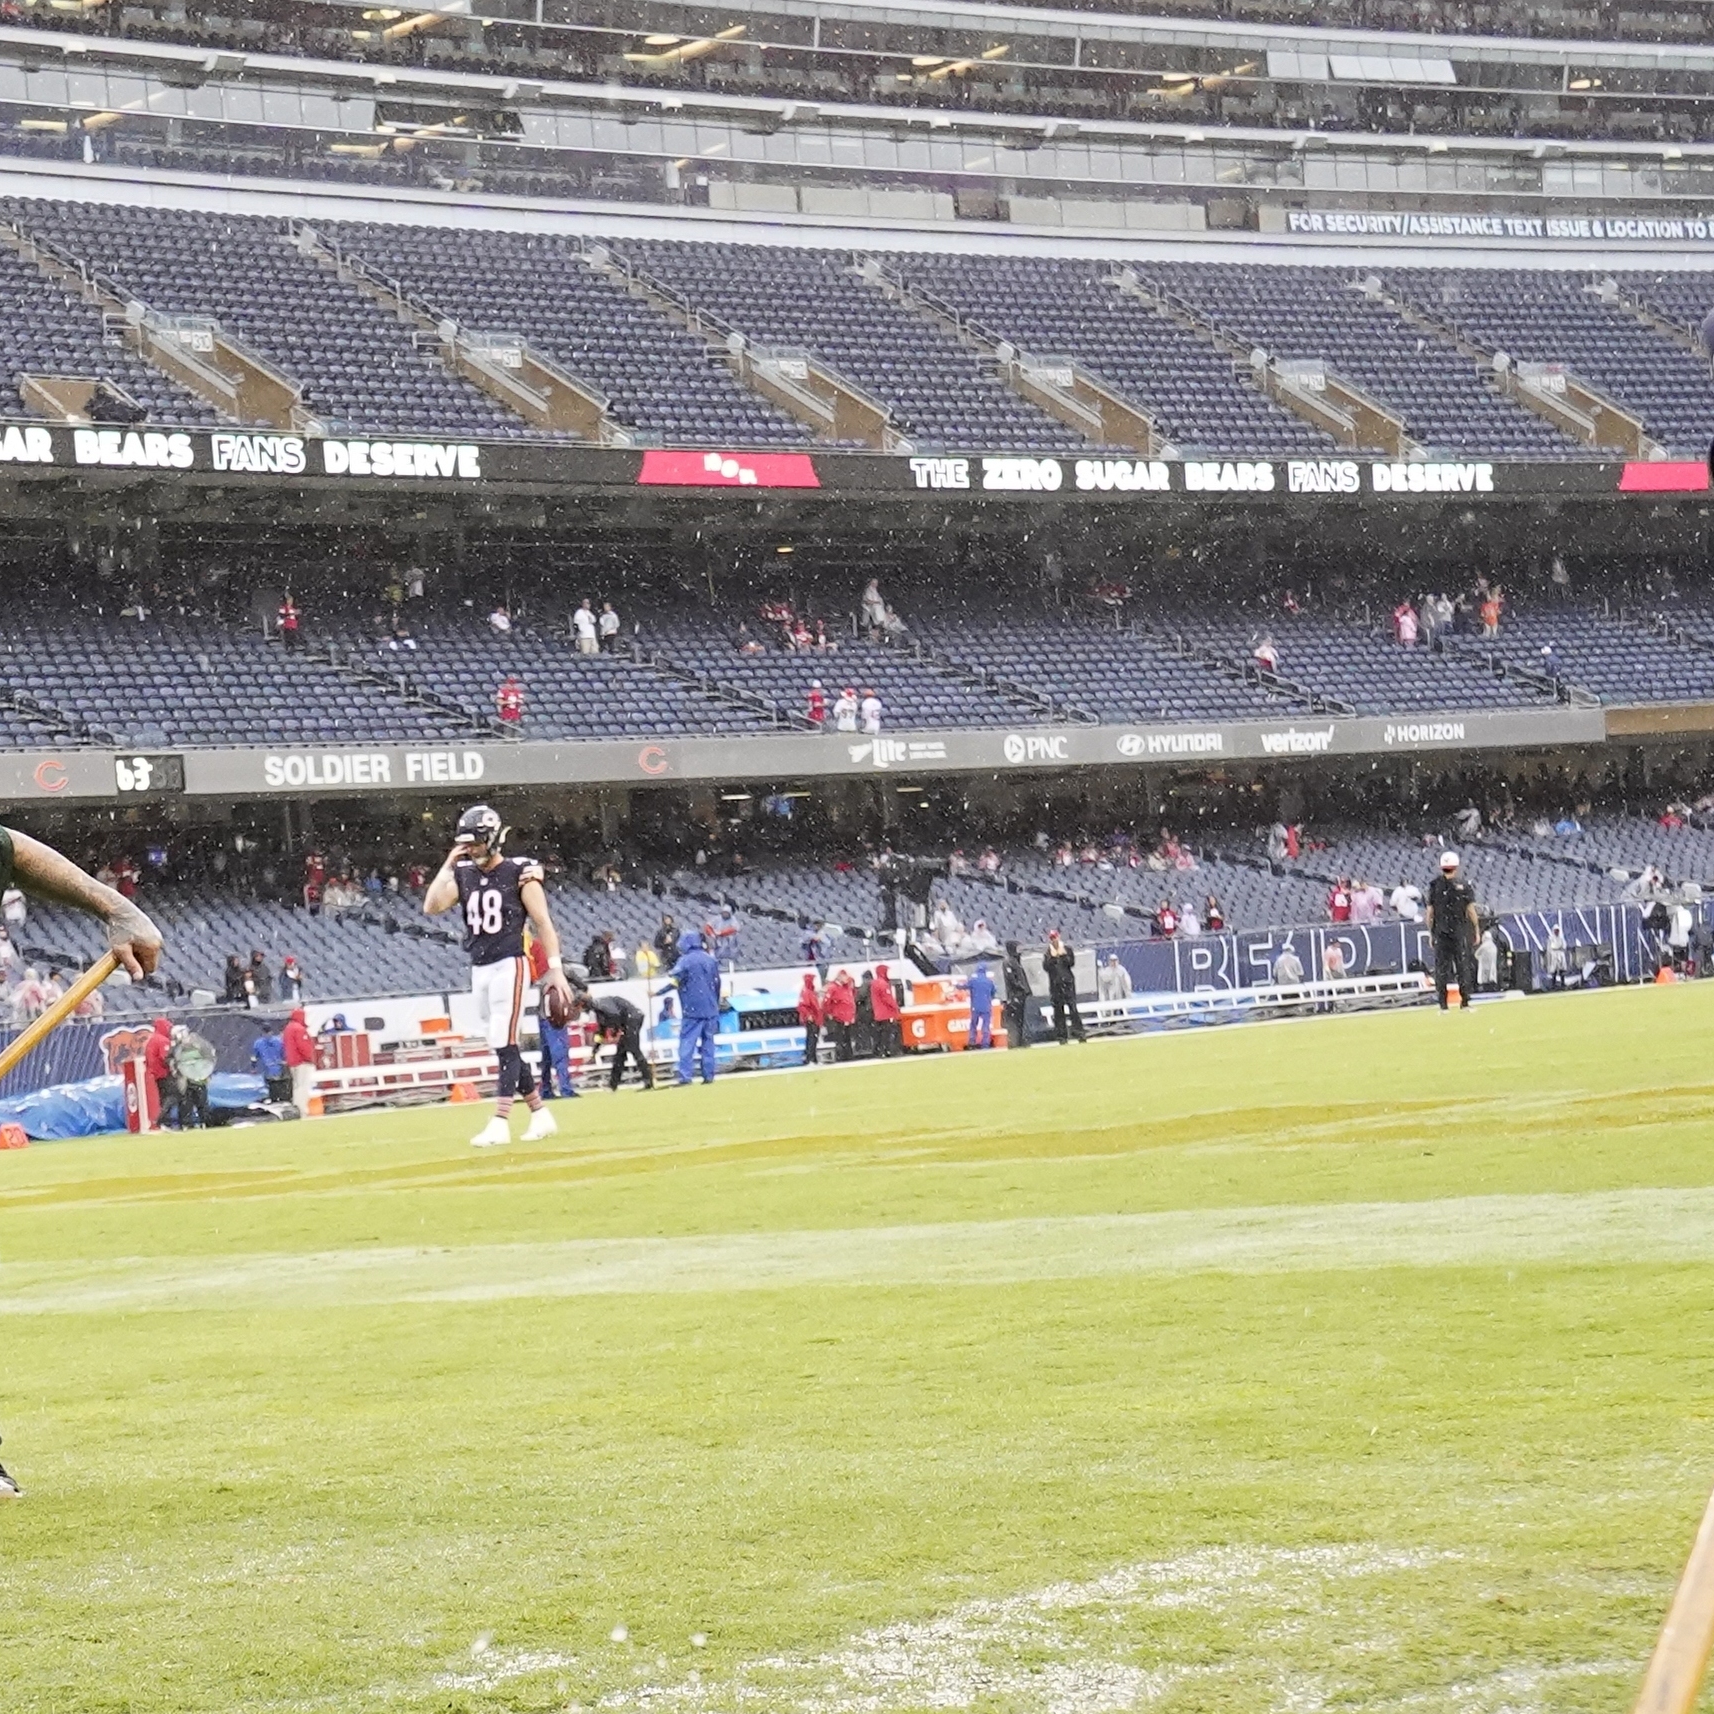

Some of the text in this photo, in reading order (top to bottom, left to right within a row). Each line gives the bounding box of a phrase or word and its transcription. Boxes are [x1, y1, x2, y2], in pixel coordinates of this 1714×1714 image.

[1289, 214, 1325, 232] FOR
[1326, 214, 1503, 236] SECURITY/ASSISTANCE
[1504, 219, 1544, 237] TEXT
[1546, 219, 1590, 238] ISSUE
[1606, 220, 1686, 239] LOCATION
[1686, 221, 1706, 239] TO
[73, 430, 194, 468] BEARS
[211, 434, 307, 474] FANS
[323, 440, 481, 478] DESERVE
[909, 458, 1494, 493] THE ZERO SUGAR BEARS FANS DESERVE
[1147, 733, 1223, 753] HYUNDAI
[1261, 726, 1331, 753] verizon
[1397, 722, 1465, 743] HORIZON
[1026, 736, 1069, 760] PNC
[265, 752, 485, 786] SOLDIER FIELD
[467, 889, 502, 935] 48
